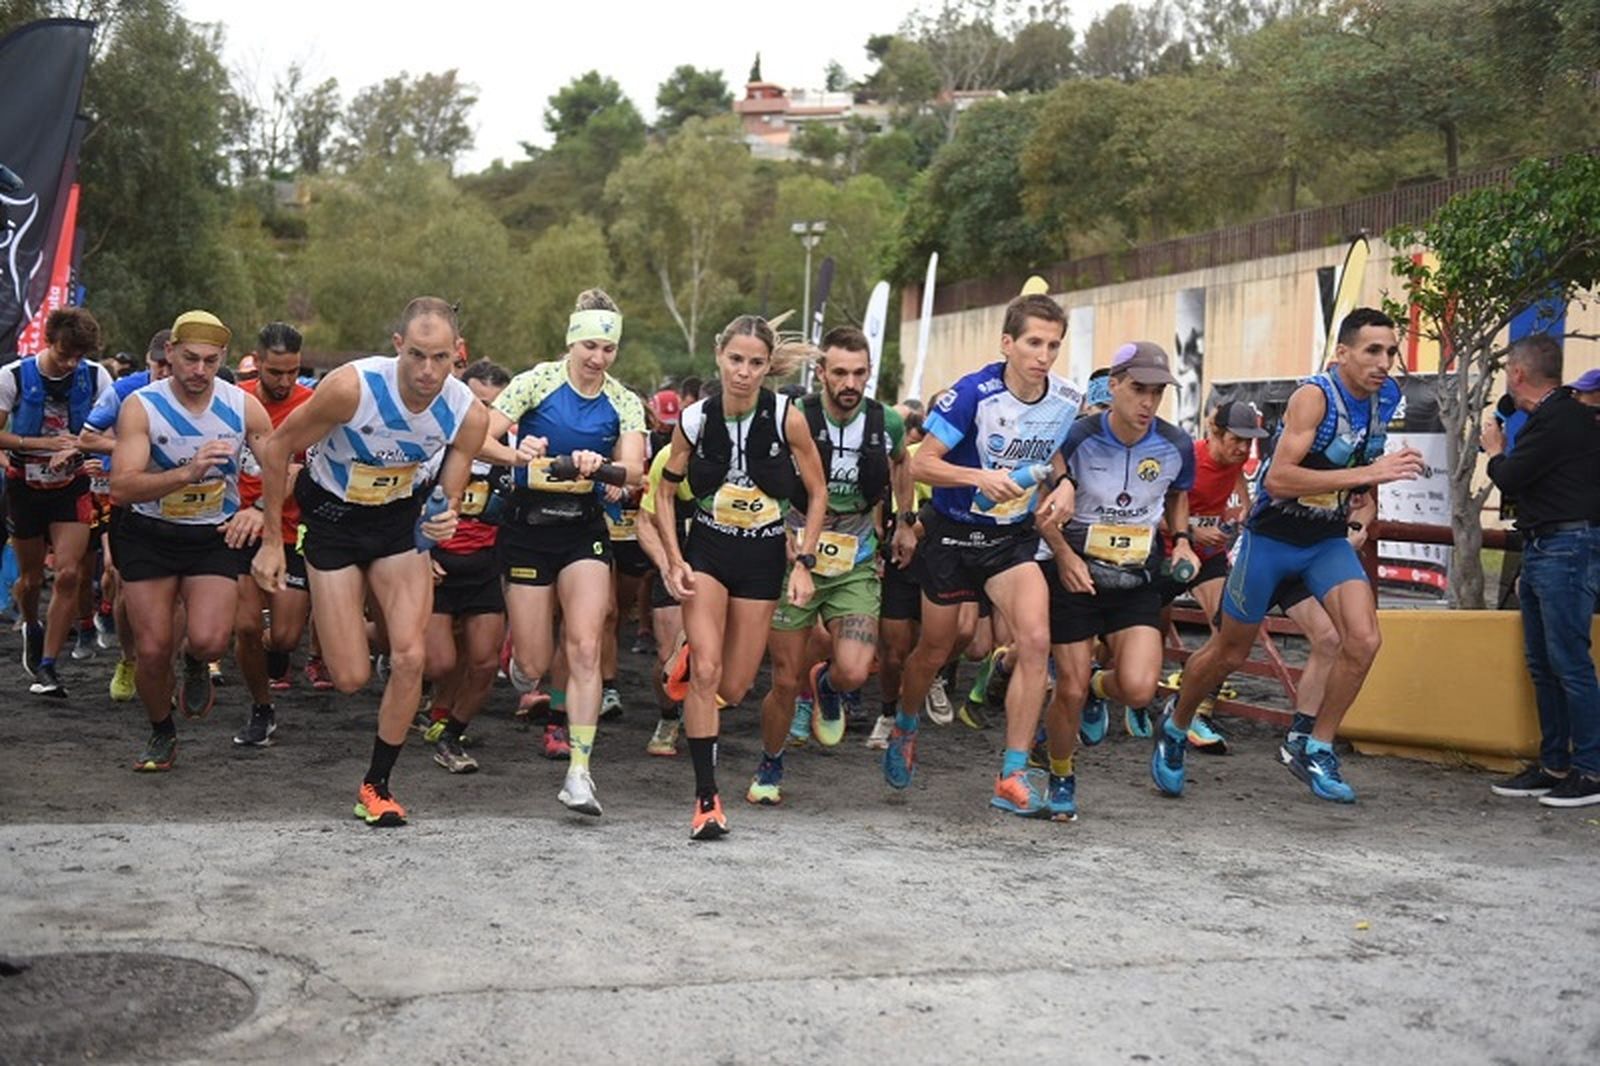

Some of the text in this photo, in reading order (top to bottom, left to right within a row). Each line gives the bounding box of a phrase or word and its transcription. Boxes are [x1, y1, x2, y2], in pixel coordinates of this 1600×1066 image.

[1003, 436, 1054, 461] motors
[372, 476, 398, 487] 21
[183, 493, 205, 503] 31
[732, 498, 764, 513] 26
[1094, 505, 1149, 517] ARGUS
[1110, 536, 1131, 549] 13
